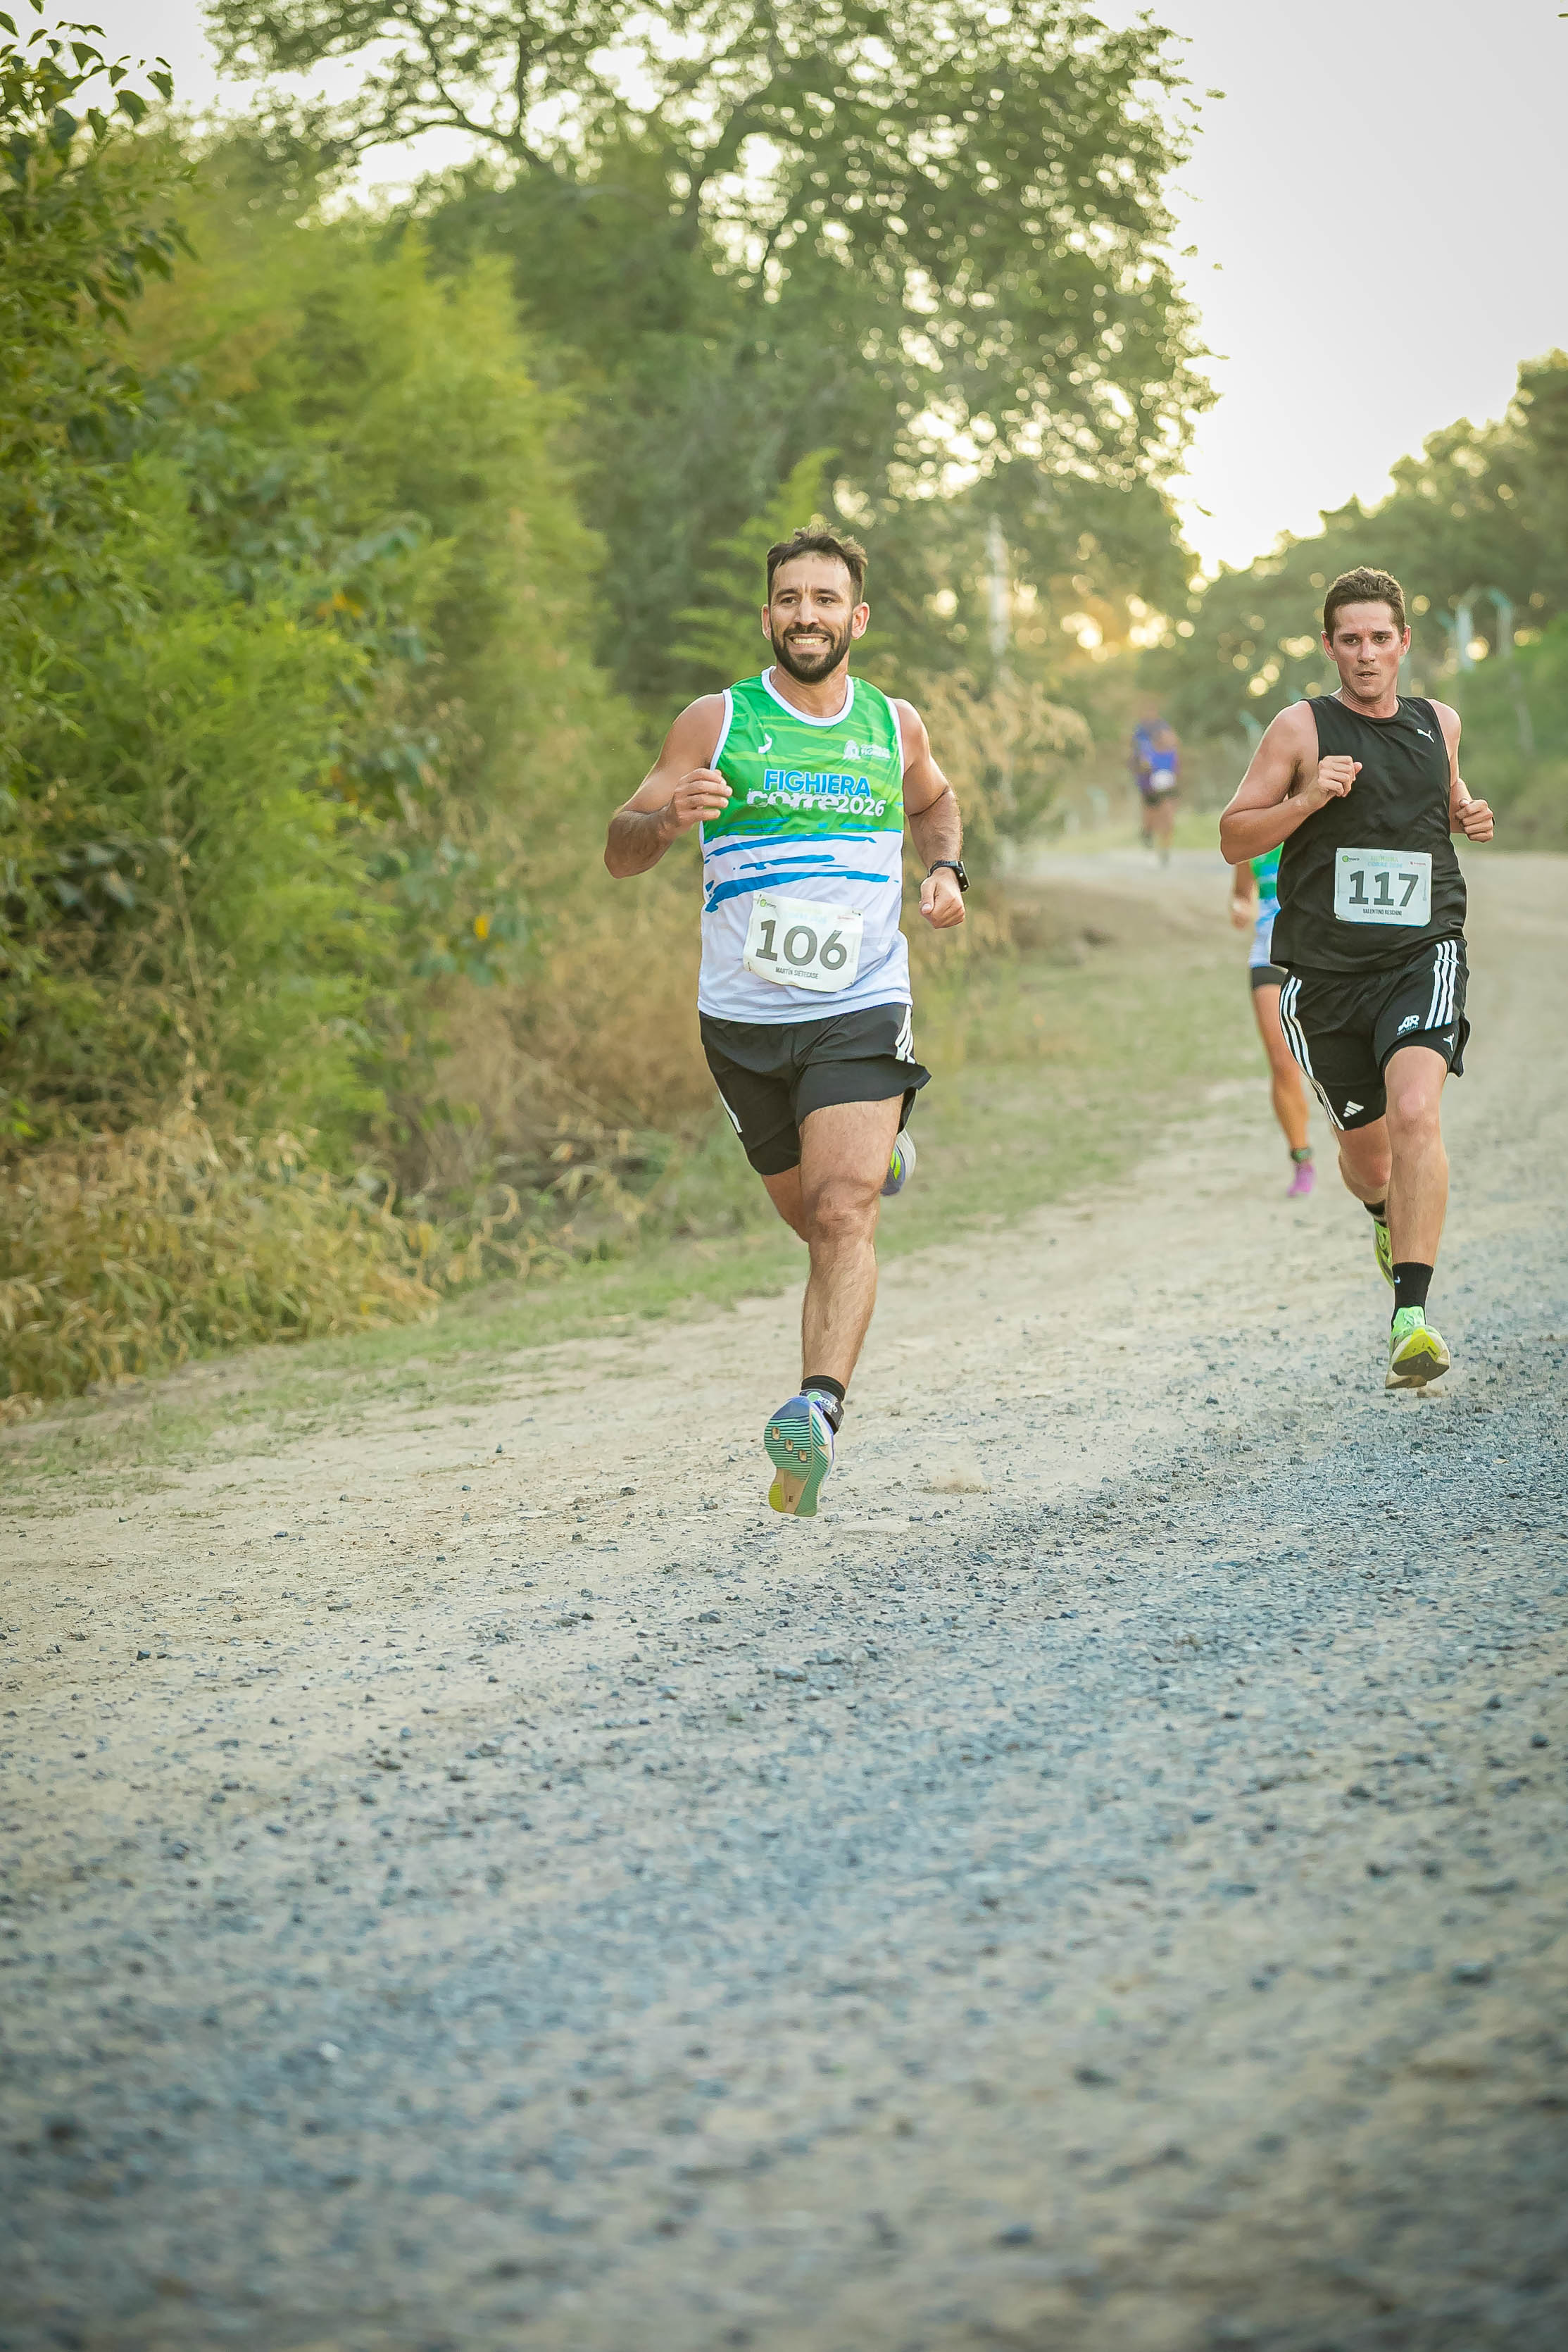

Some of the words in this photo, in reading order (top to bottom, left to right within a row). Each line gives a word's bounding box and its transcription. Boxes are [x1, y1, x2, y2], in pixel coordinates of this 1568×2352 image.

[764, 769, 872, 797] FIGHIERA
[1348, 870, 1419, 907] 117
[755, 919, 848, 970] 106
